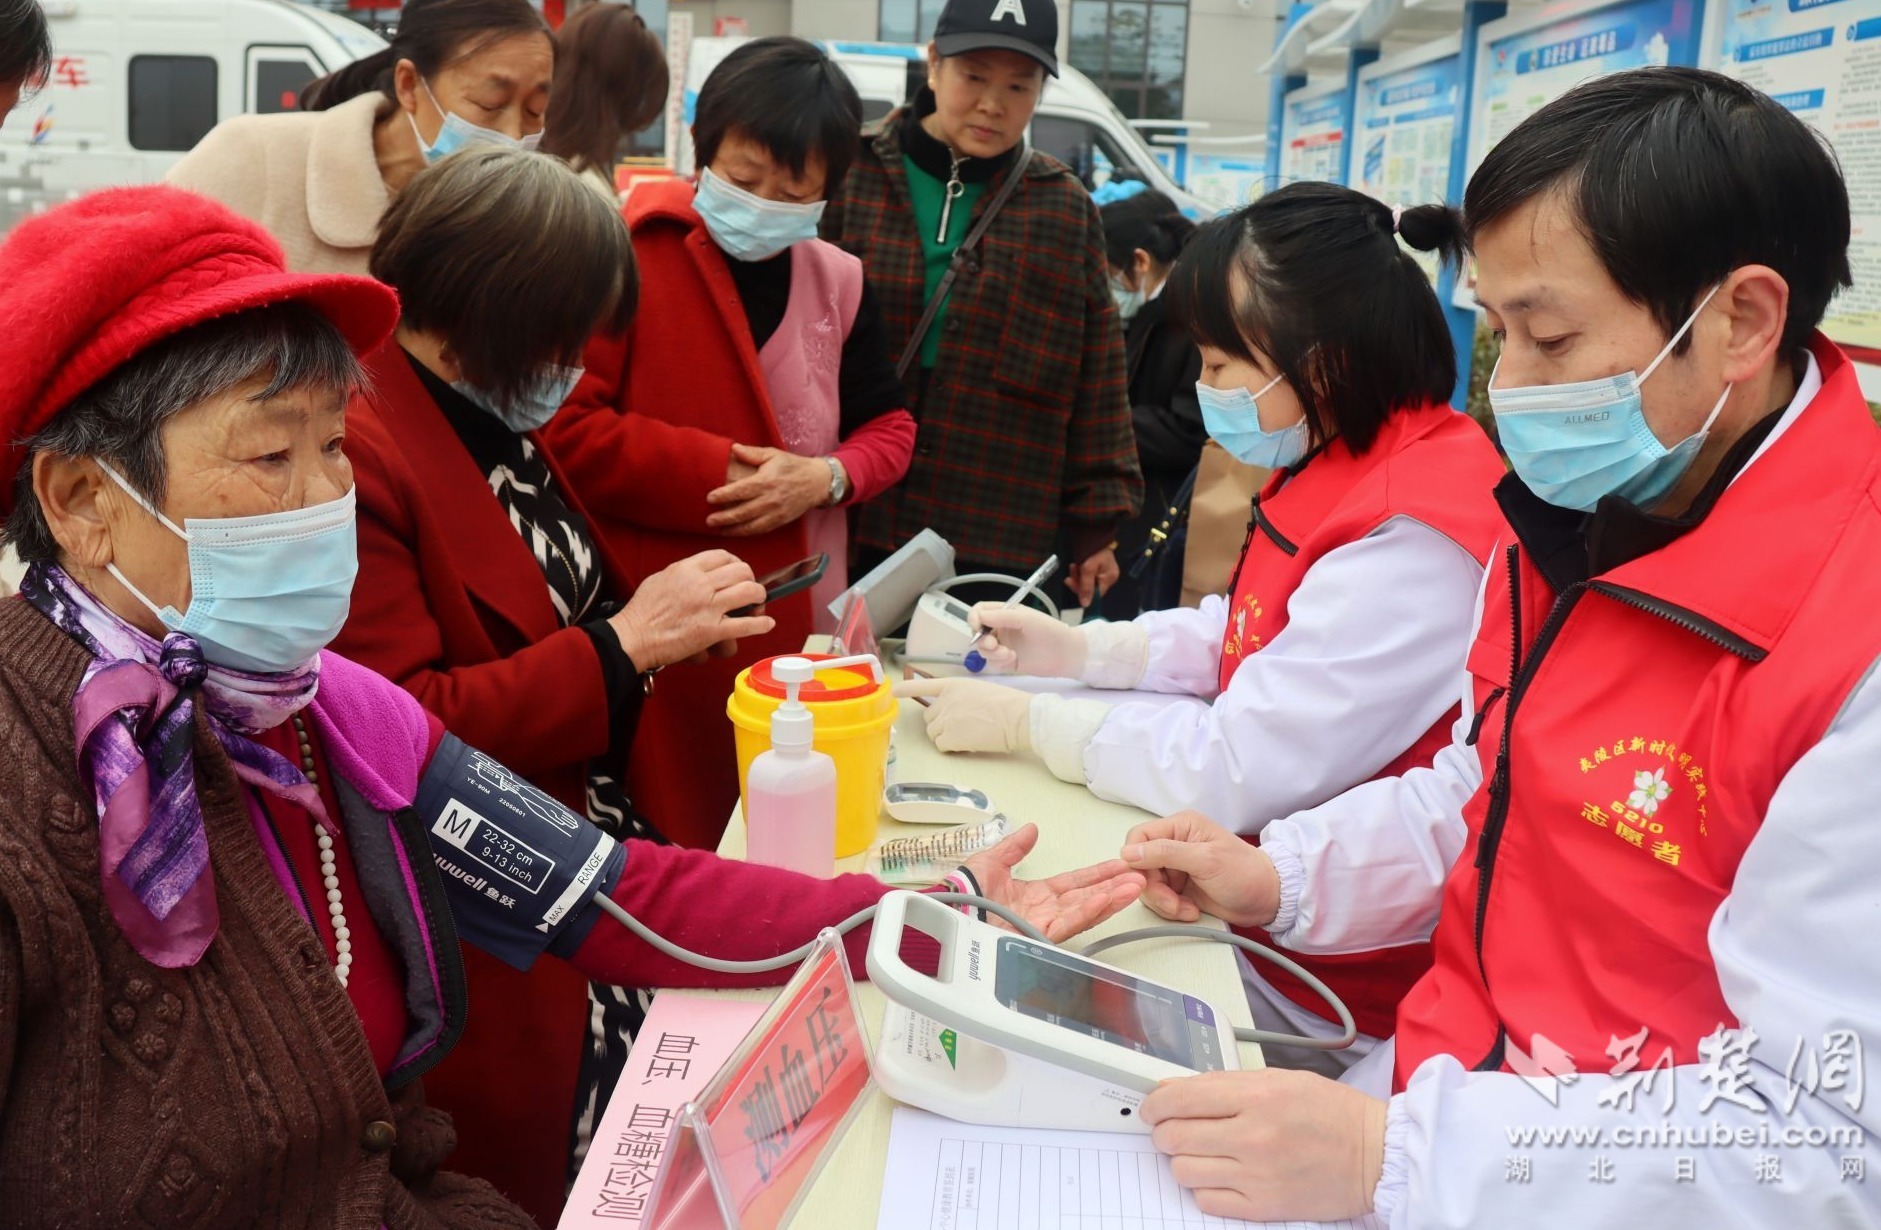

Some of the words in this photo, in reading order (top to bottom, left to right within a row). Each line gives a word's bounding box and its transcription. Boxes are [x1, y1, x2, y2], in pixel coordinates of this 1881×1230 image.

[990, 0, 1027, 26] A
[1564, 410, 1610, 425] ALLMED
[443, 809, 472, 839] M
[1610, 800, 1664, 834] 5210
[483, 828, 516, 855] 22-32
[516, 851, 533, 866] cm
[1580, 802, 1682, 866] 志愿者
[481, 846, 507, 867] 9-13
[508, 862, 533, 883] inch
[577, 852, 603, 885] RANGE
[484, 886, 516, 909] 鱼跃
[549, 904, 565, 922] MAX
[739, 986, 848, 1183] 测血压
